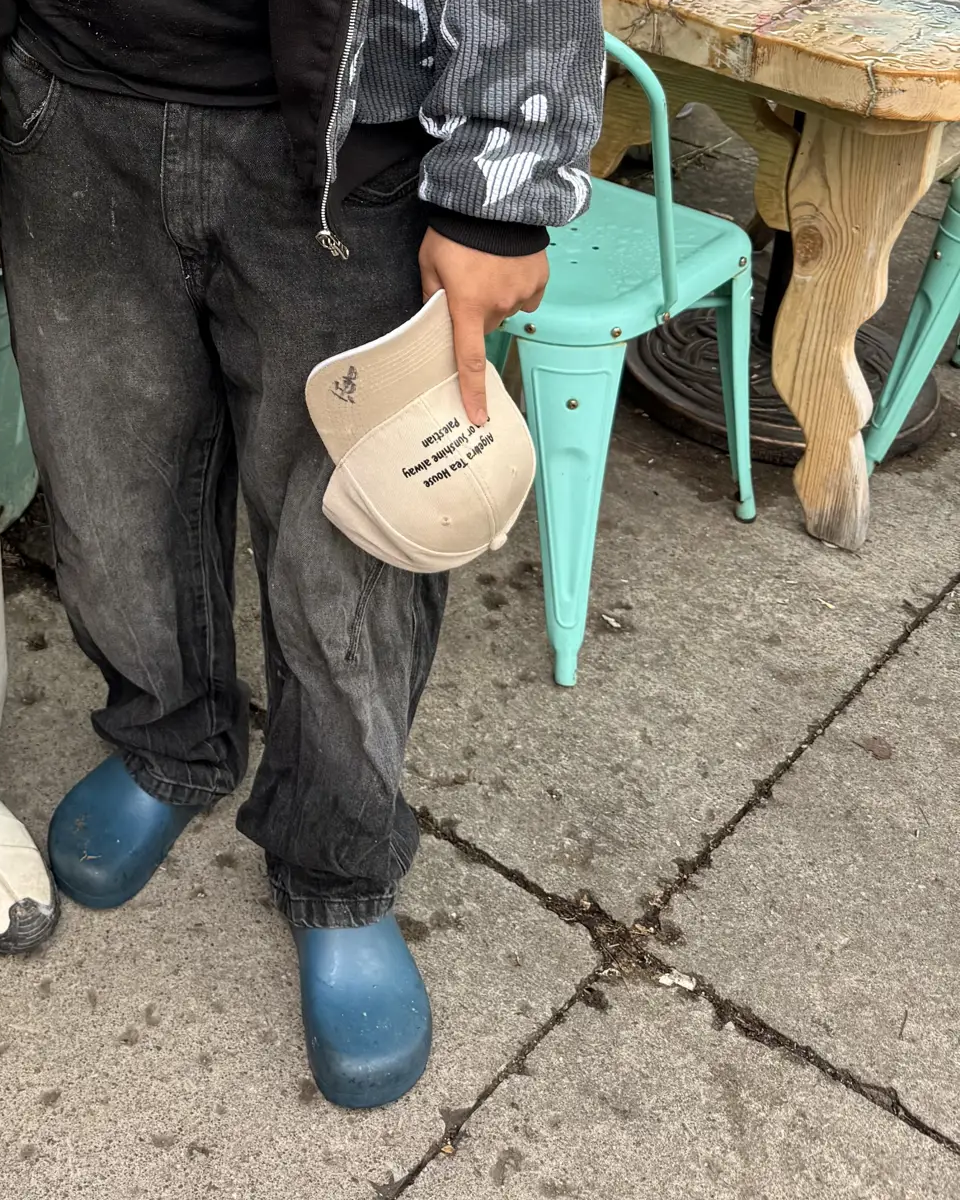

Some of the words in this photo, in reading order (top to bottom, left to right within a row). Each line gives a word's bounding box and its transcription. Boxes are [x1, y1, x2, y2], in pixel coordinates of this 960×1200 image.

[421, 417, 461, 448] Palestian
[467, 425, 476, 437] or
[431, 432, 469, 463] Sunshine
[466, 432, 494, 460] Algebra
[401, 459, 432, 478] alway
[449, 458, 469, 472] Tea
[423, 468, 452, 487] House
